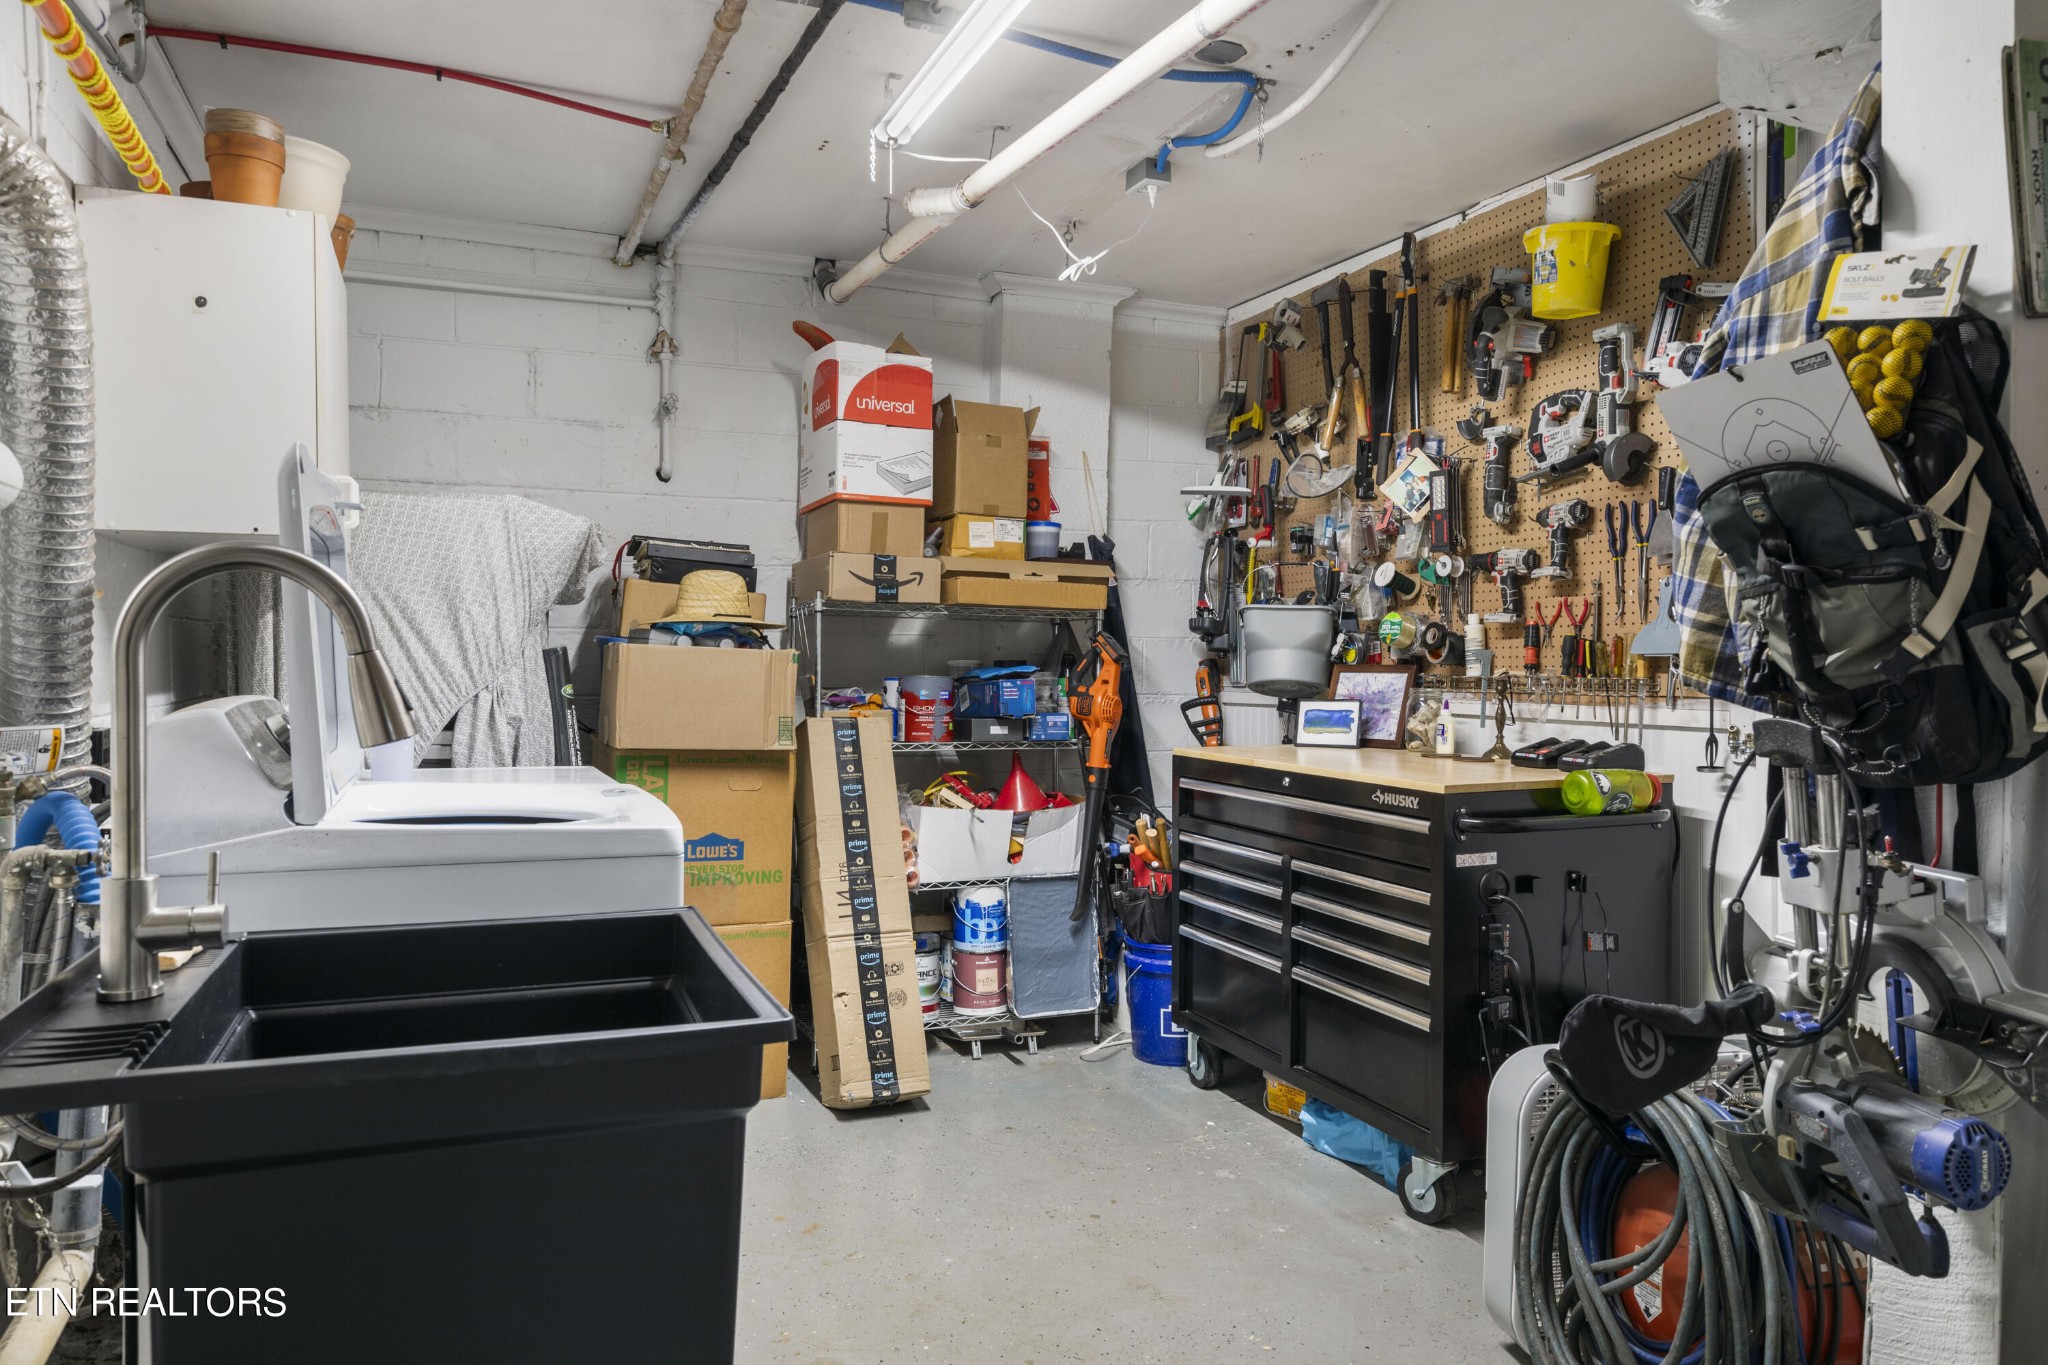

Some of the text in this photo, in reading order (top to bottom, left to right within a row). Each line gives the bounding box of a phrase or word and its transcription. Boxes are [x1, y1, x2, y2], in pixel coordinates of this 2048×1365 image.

[2031, 149, 2043, 206] KNOX
[1847, 264, 1870, 272] SKLZ
[1862, 274, 1885, 282] BALLS
[856, 395, 915, 415] universal
[837, 728, 856, 736] prime
[676, 754, 786, 766] Lowes.com/Moving
[843, 782, 862, 791] prime
[1384, 792, 1420, 809] HUSKY
[848, 840, 868, 848] prime
[687, 843, 739, 859] LOWE'S
[718, 863, 744, 873] STOP
[690, 869, 783, 887] IMPROVING
[854, 896, 874, 905] prime
[860, 952, 880, 961] prime
[866, 1010, 886, 1020] prime
[874, 1071, 894, 1080] prime
